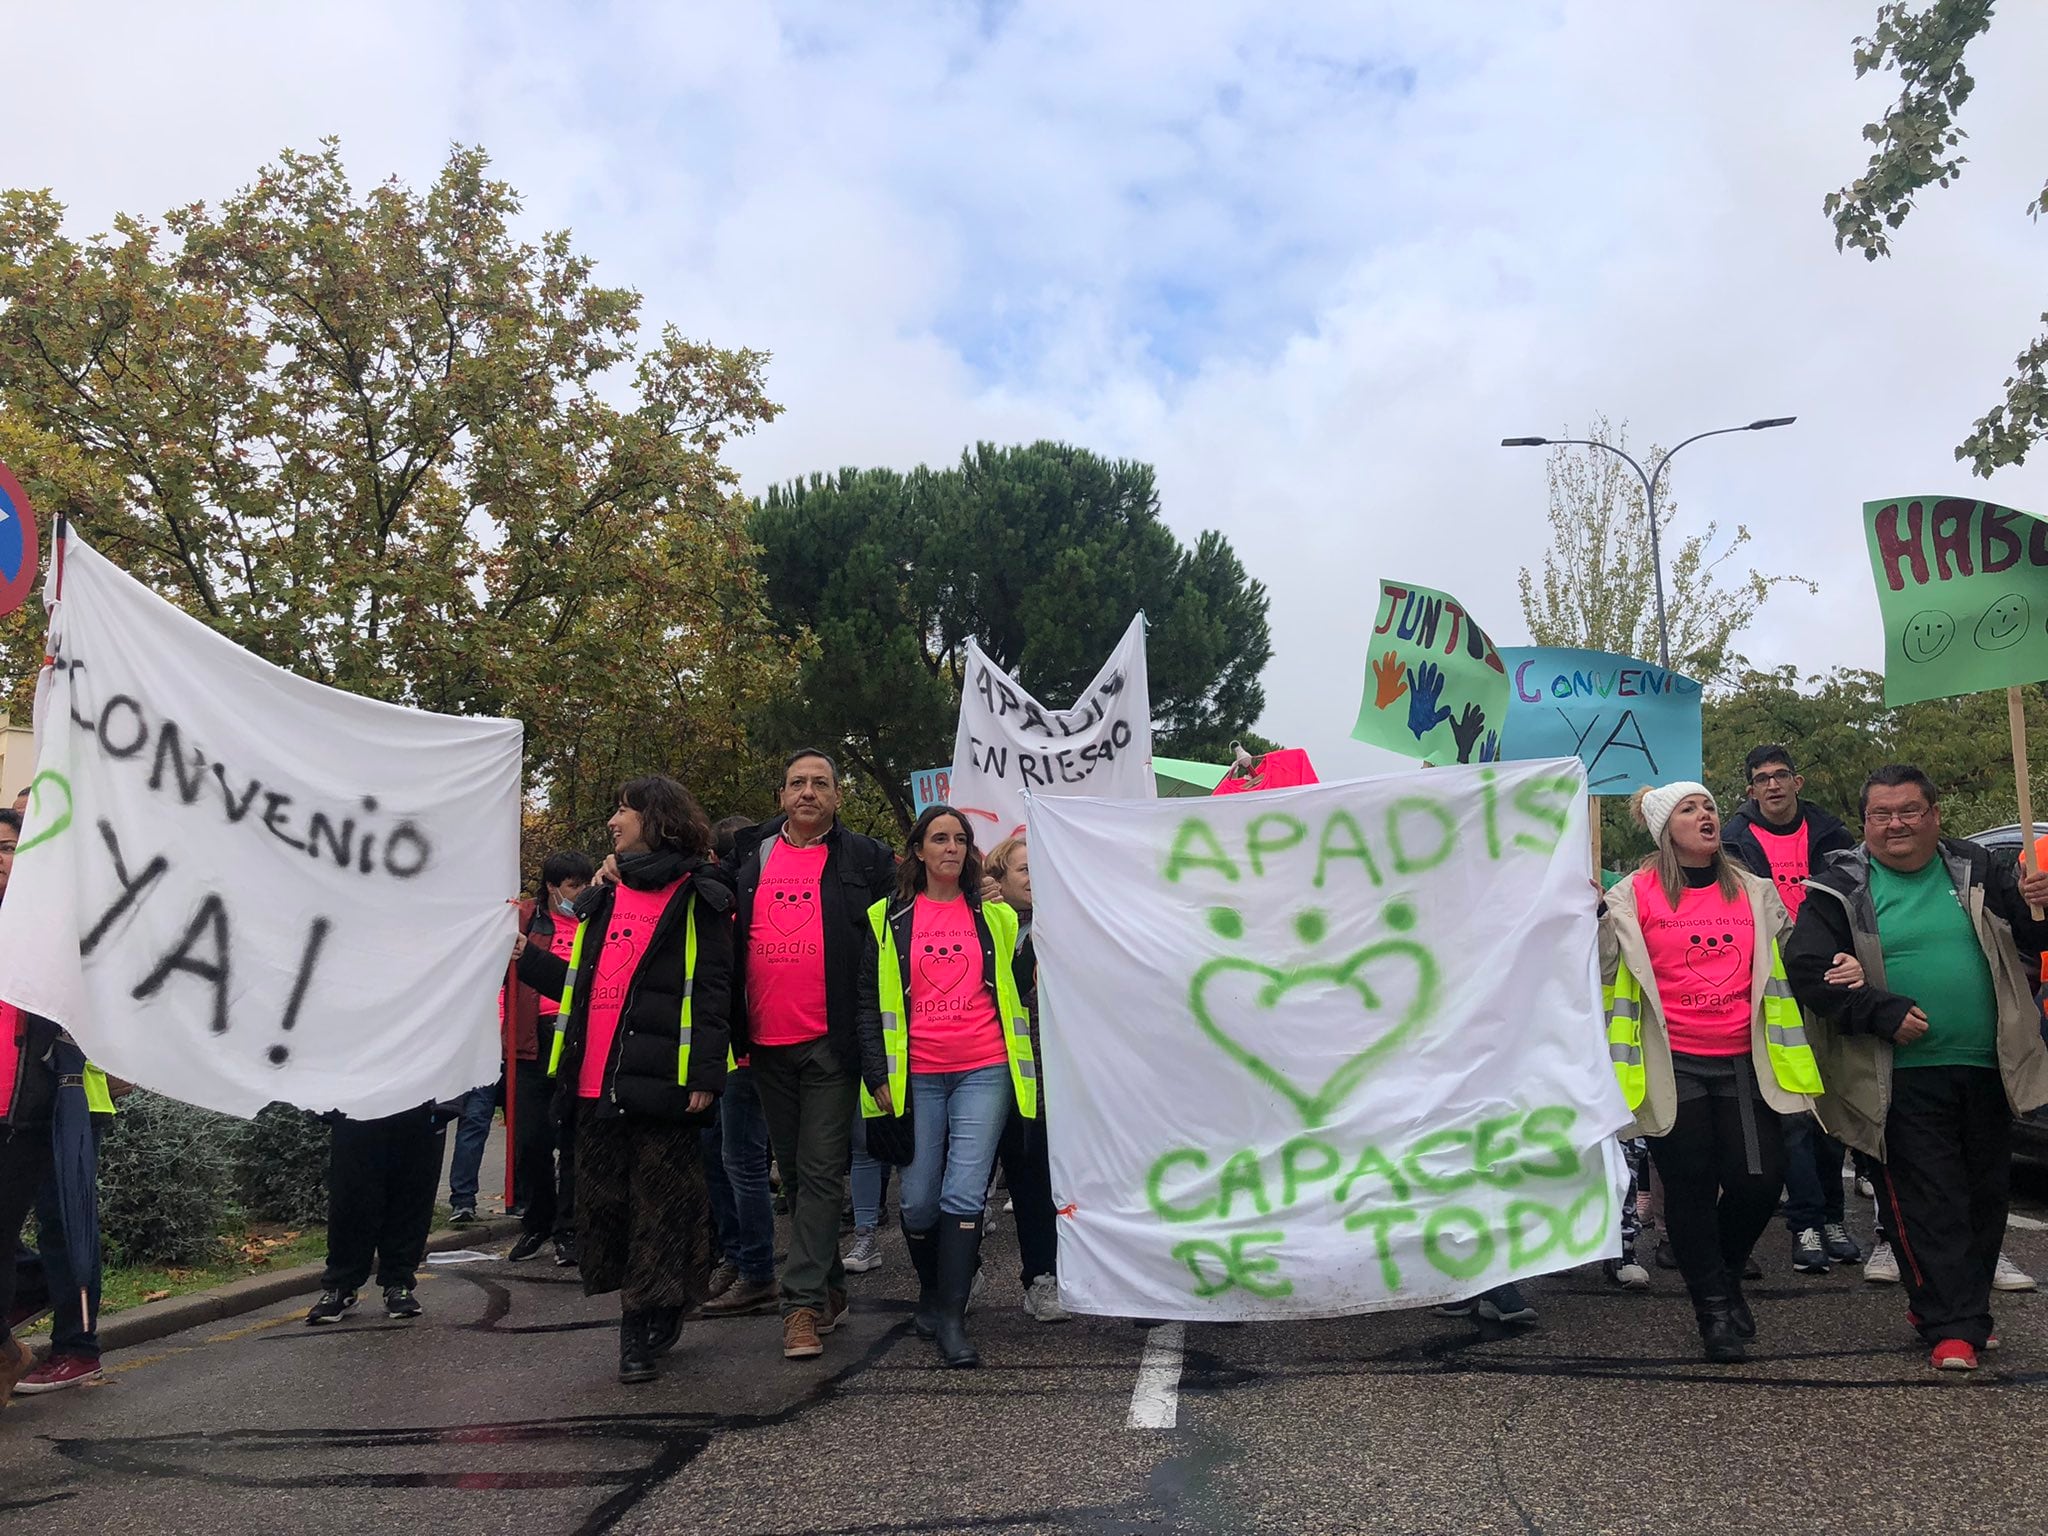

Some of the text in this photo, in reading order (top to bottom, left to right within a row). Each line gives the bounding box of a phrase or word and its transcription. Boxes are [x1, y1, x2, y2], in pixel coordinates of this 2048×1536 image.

[1556, 707, 1659, 776] YA
[919, 771, 952, 804] HA
[80, 817, 331, 1066] YA!
[1715, 917, 1730, 926] de
[756, 940, 817, 958] apadis
[915, 995, 974, 1017] apadis
[1146, 1105, 1583, 1225] CAPACES
[1171, 1230, 1294, 1298] DE
